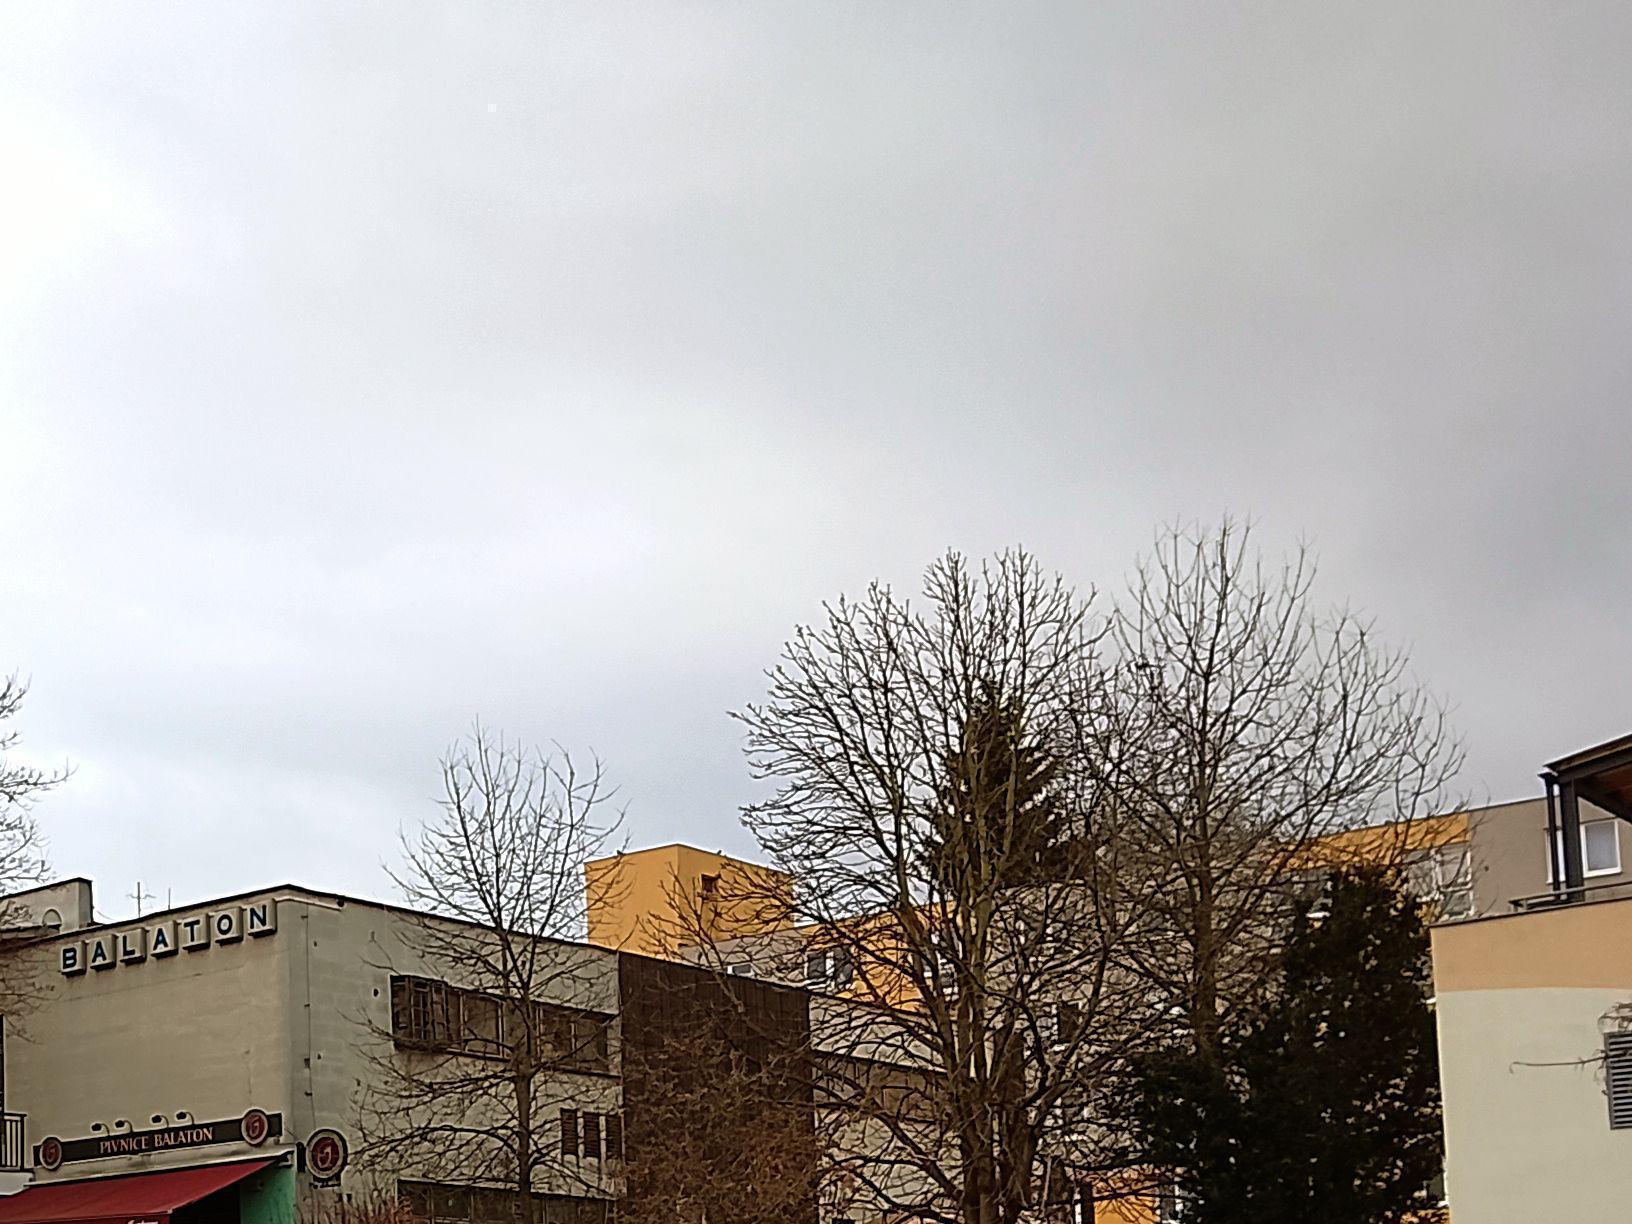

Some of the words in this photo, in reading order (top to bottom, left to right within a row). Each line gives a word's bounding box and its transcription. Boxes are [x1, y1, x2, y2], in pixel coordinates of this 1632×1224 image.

[62, 904, 267, 970] BALATON
[100, 1136, 149, 1154] PIVNICE
[154, 1127, 214, 1148] BALATON
